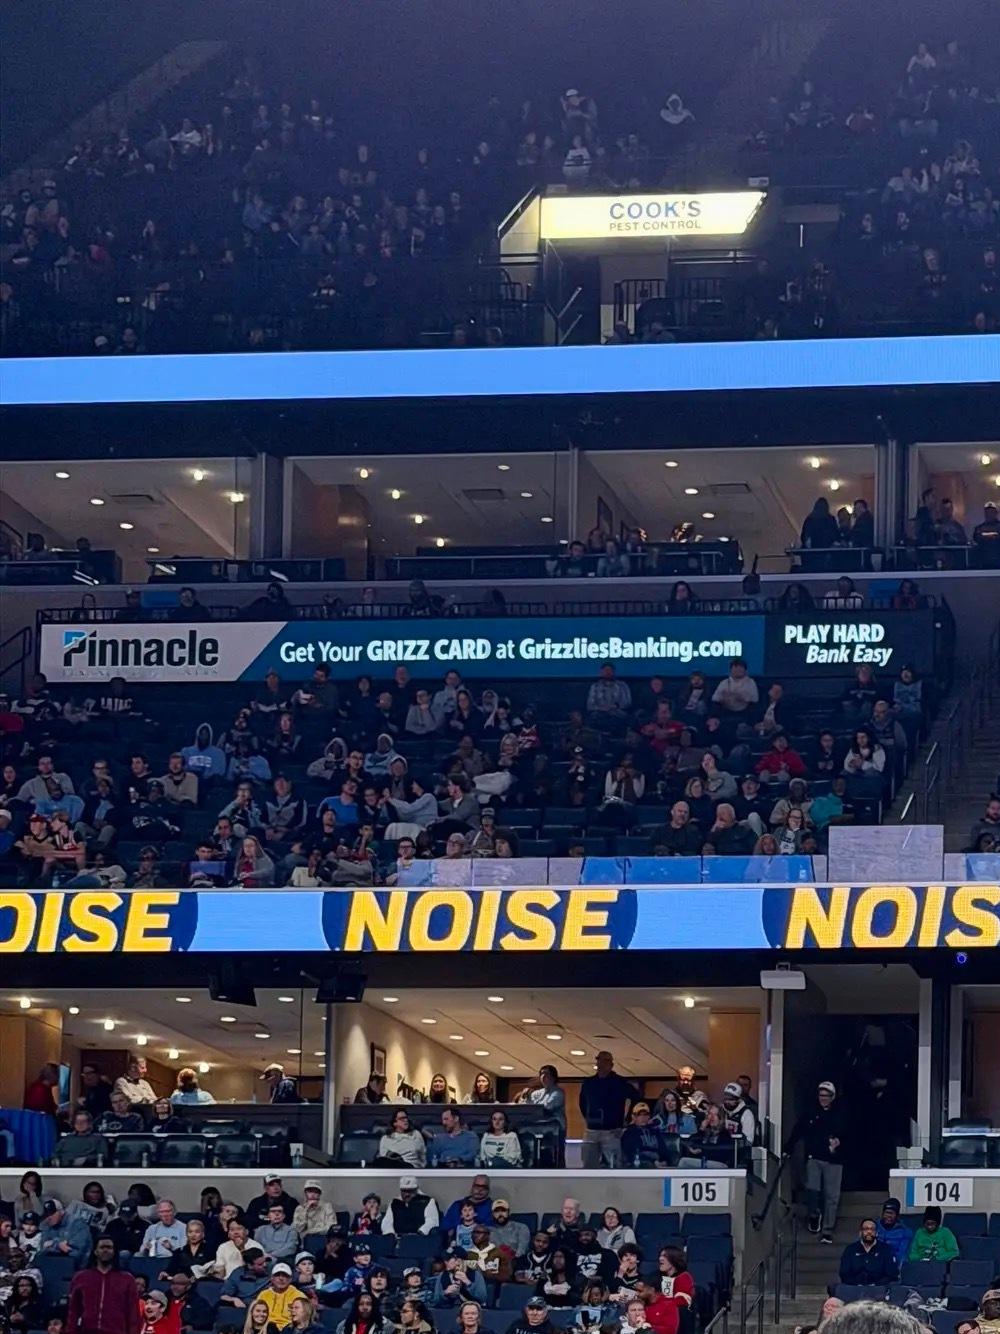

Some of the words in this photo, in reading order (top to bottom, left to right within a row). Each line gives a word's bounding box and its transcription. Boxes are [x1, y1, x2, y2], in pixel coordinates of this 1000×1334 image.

[609, 200, 701, 219] COOK'S
[609, 221, 639, 232] PEST
[642, 220, 701, 231] CONTROL
[784, 624, 831, 644] PLAY
[833, 623, 885, 643] HARD
[63, 630, 219, 667] Pinnacle
[280, 642, 314, 663] Get
[318, 640, 365, 663] Your
[367, 638, 429, 662] GRIZZ
[433, 638, 489, 661] CARD
[495, 639, 515, 661] at
[519, 637, 742, 663] GrizzliesBanking.com
[806, 644, 849, 664] Bank
[853, 645, 893, 666] Easy
[344, 889, 618, 952] NOISE
[680, 1181, 717, 1203] 105
[924, 1181, 961, 1203] 104
